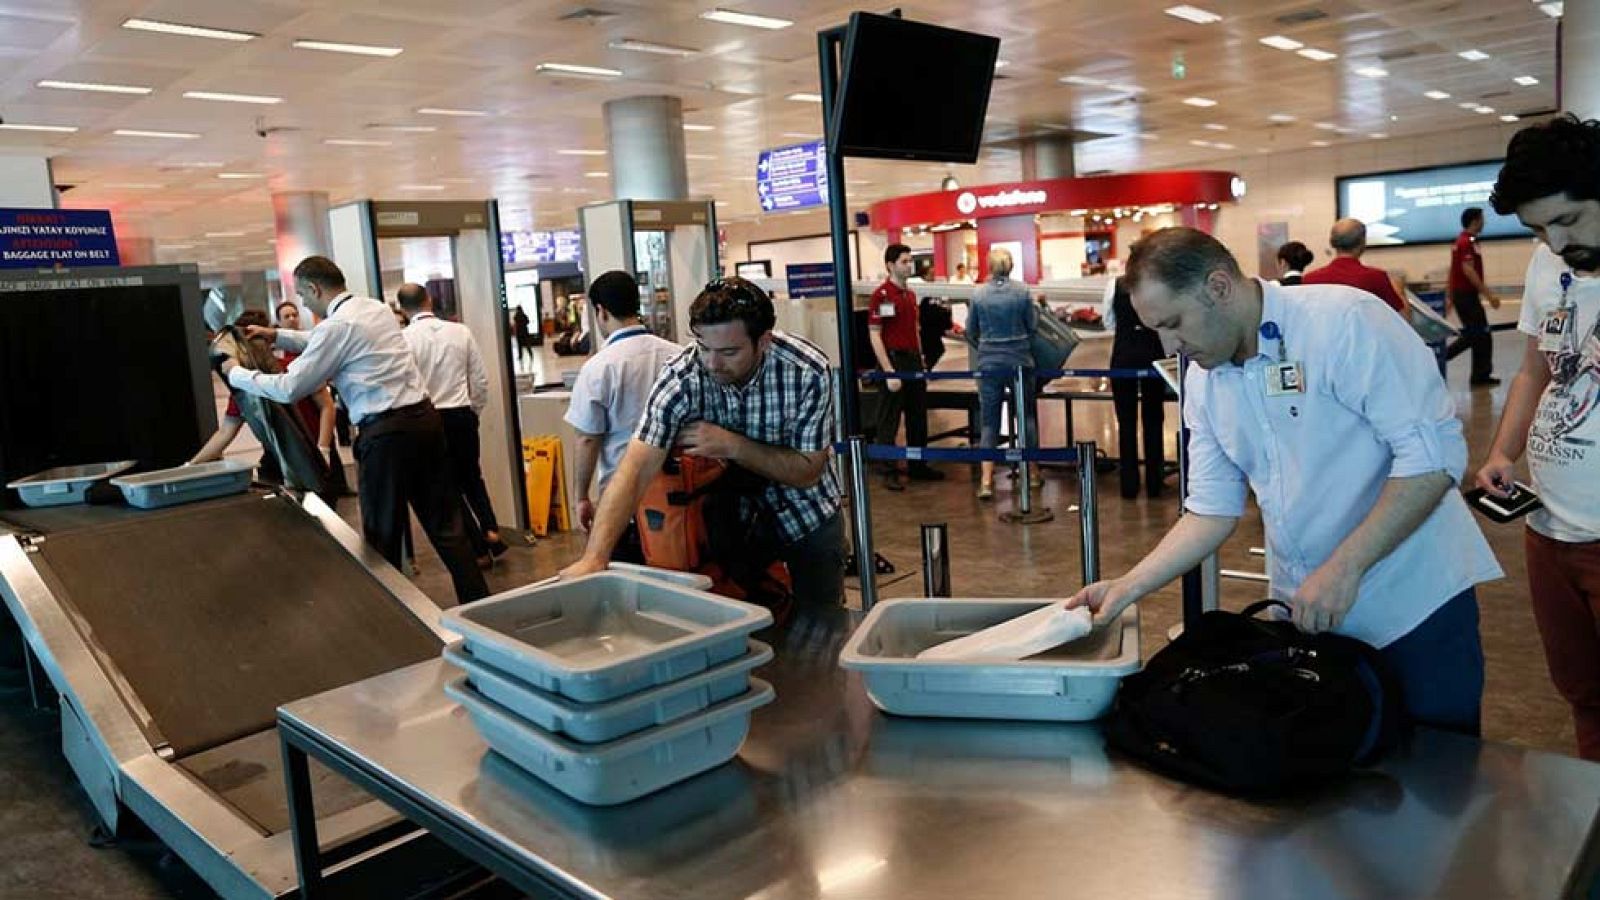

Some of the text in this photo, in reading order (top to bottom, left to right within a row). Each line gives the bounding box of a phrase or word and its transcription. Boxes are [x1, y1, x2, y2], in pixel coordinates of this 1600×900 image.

[978, 189, 1047, 208] vodafone
[32, 226, 62, 235] YATAY
[3, 249, 110, 260] BAGGAGE FLAT ON BELT
[1548, 444, 1586, 461] ASSN
